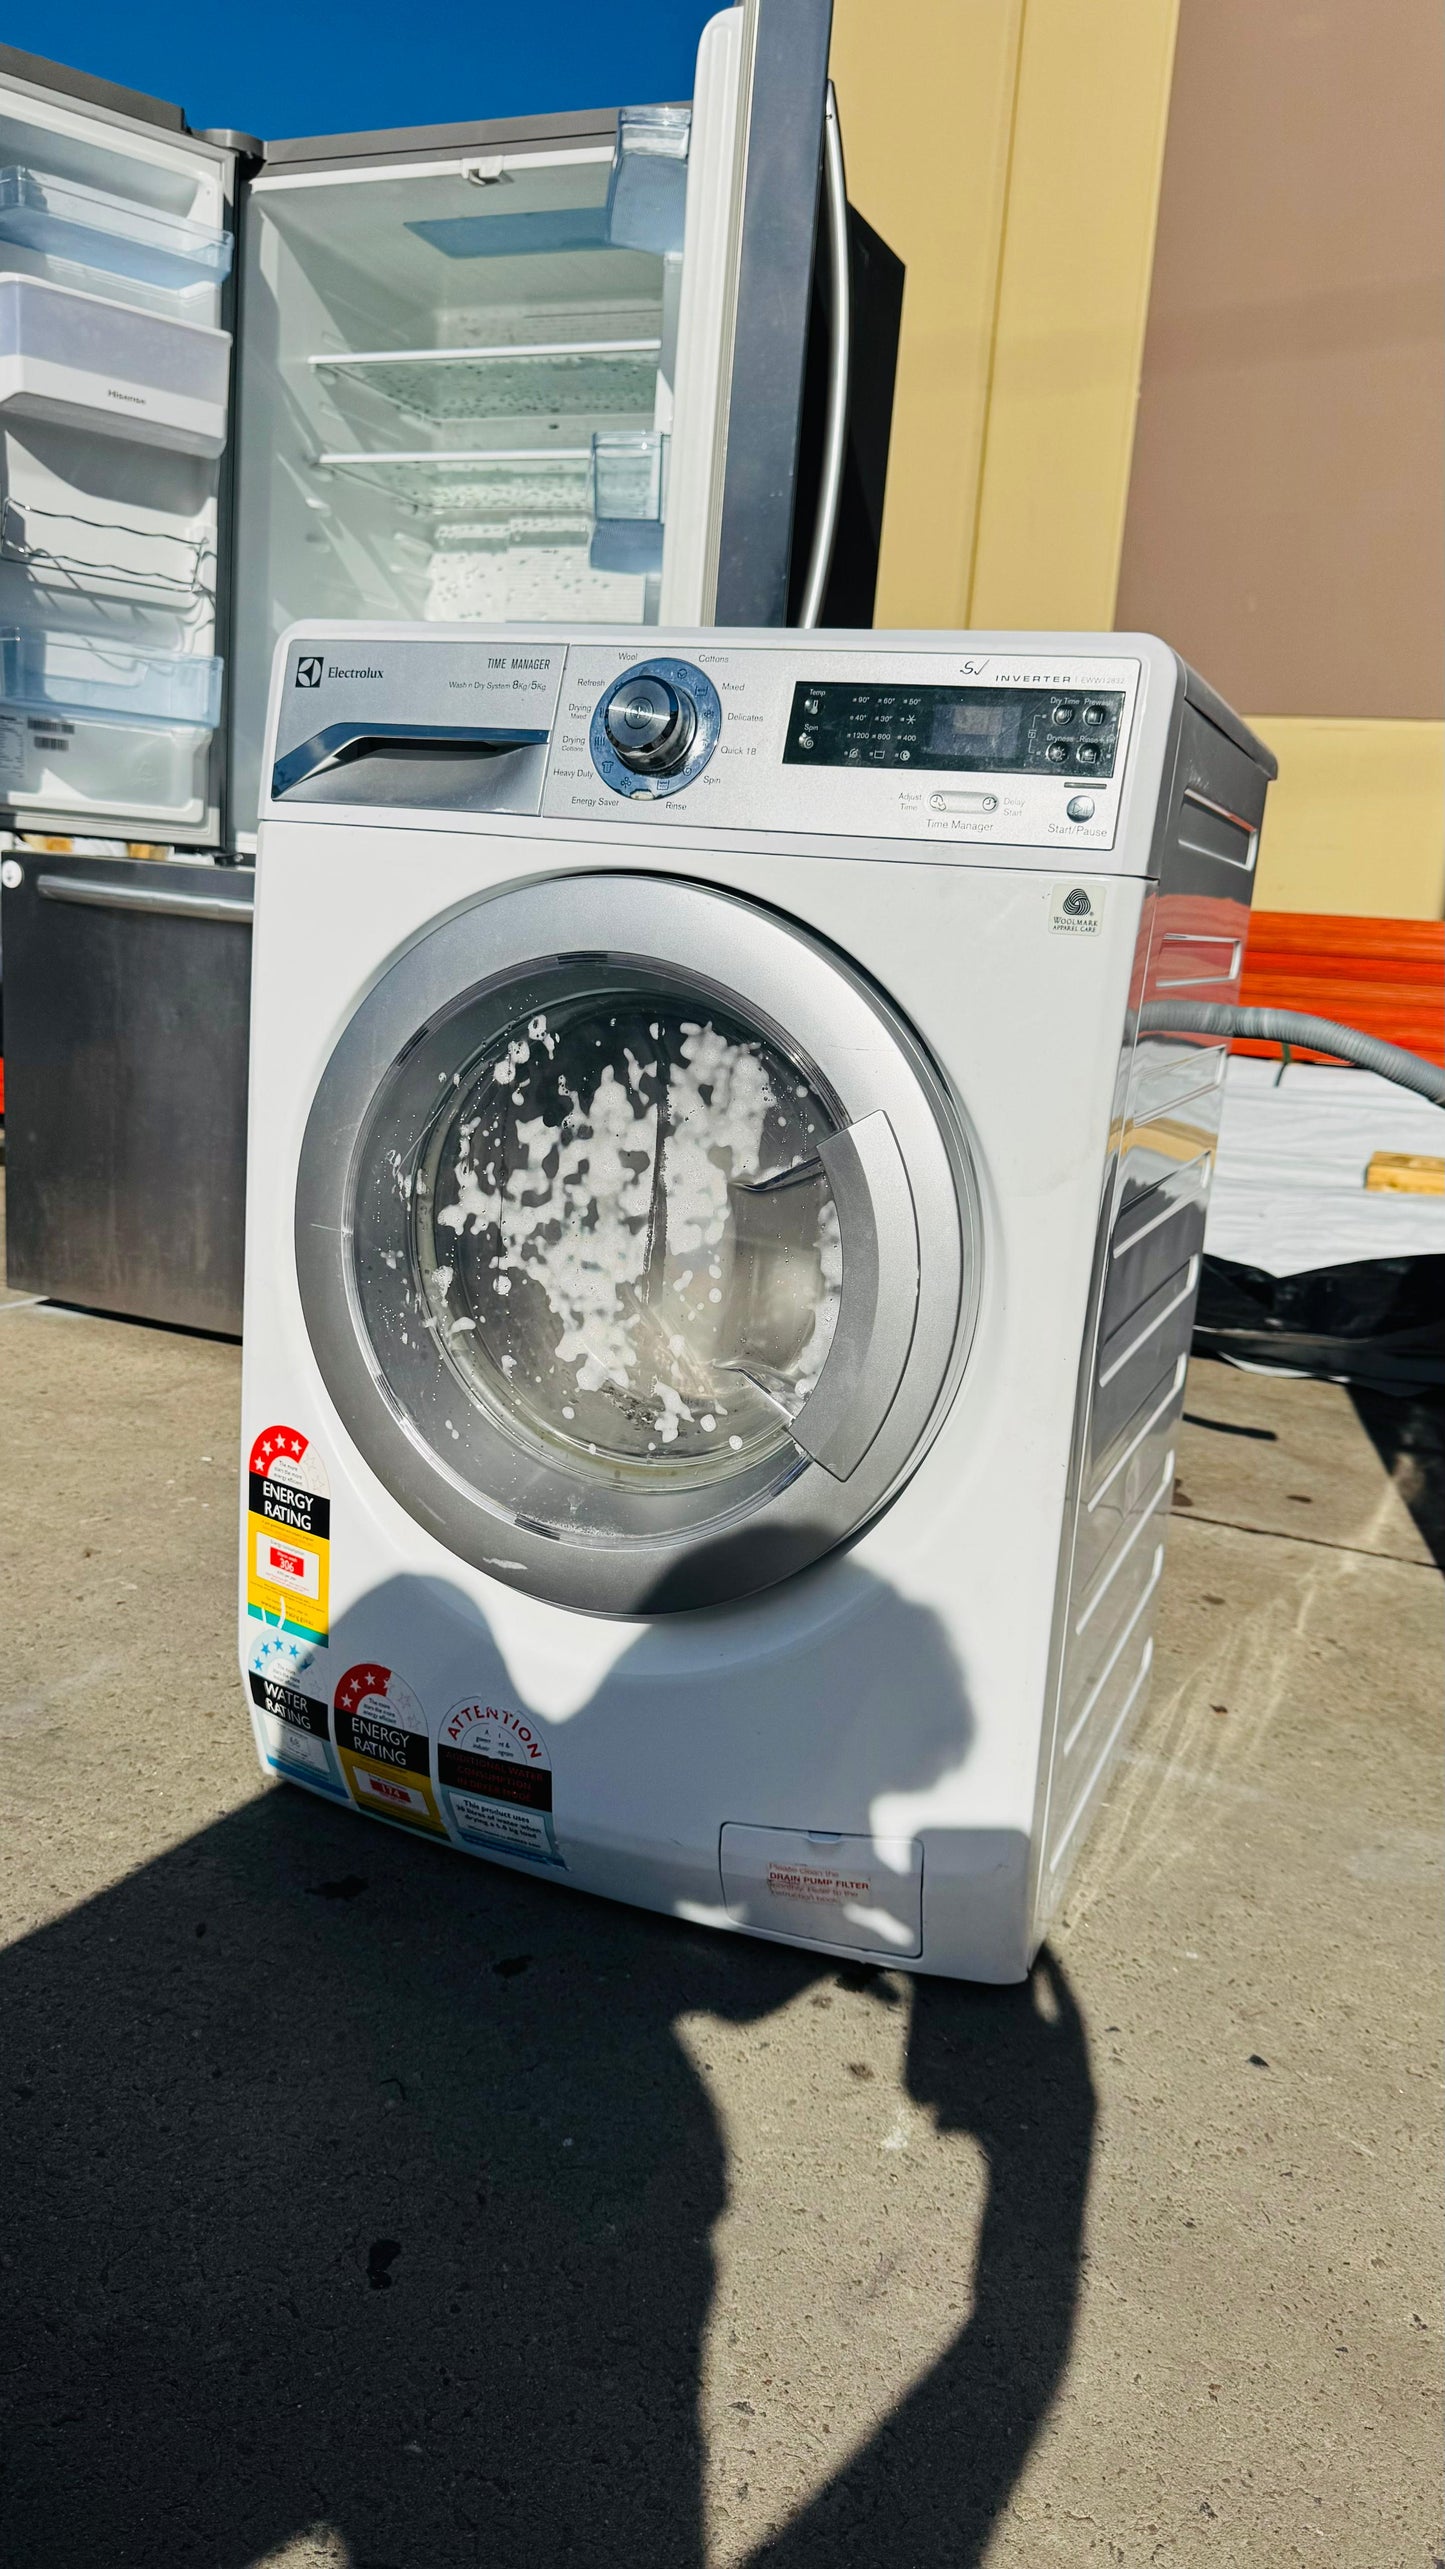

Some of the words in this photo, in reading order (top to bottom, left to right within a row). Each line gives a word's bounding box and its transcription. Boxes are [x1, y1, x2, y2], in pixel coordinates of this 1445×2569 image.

[618, 652, 638, 661] Wool
[698, 655, 729, 664] Cottons
[487, 658, 507, 669] TIME
[511, 658, 551, 670] MANAGER
[328, 666, 384, 680] Electrolux
[995, 674, 1071, 683] INVERTER
[448, 681, 467, 689] Wash
[474, 681, 485, 691] Dry
[487, 681, 511, 691] System
[577, 678, 606, 687] Refresh
[722, 682, 745, 691] Mixed
[809, 689, 826, 697] Temp
[1050, 697, 1062, 705] Dry
[568, 703, 592, 714] Drying
[728, 712, 764, 722] Delicates
[804, 724, 819, 732] Spin
[562, 735, 586, 746] Drying
[720, 745, 743, 755] Quick
[553, 768, 576, 778] Heavy
[577, 769, 594, 779] Duty
[703, 775, 721, 785] Spin
[571, 797, 596, 808] Energy
[598, 798, 620, 807] Saver
[898, 793, 922, 802] Adjust
[1003, 798, 1025, 807] Delay
[665, 802, 687, 811] Rinse
[900, 803, 918, 811] Time
[1003, 808, 1023, 817] Start
[926, 819, 949, 829] Time
[951, 820, 994, 832] Manager
[1048, 824, 1108, 837] Start/Pause
[1053, 916, 1098, 927] WOOLMARK
[263, 1480, 314, 1512] ENERGY
[264, 1500, 312, 1531] RATING
[280, 1558, 295, 1573] 306
[263, 1680, 309, 1713] WATER
[265, 1697, 312, 1730] RATING
[351, 1717, 410, 1749] ENERGY
[447, 1704, 542, 1759] ATTENTION
[353, 1736, 407, 1766] RATING
[463, 1799, 480, 1810] This
[481, 1805, 511, 1819] product
[512, 1814, 530, 1824] uses
[769, 1872, 800, 1884] DRAIN
[803, 1876, 833, 1886] PUMP
[835, 1880, 869, 1890] FILTER
